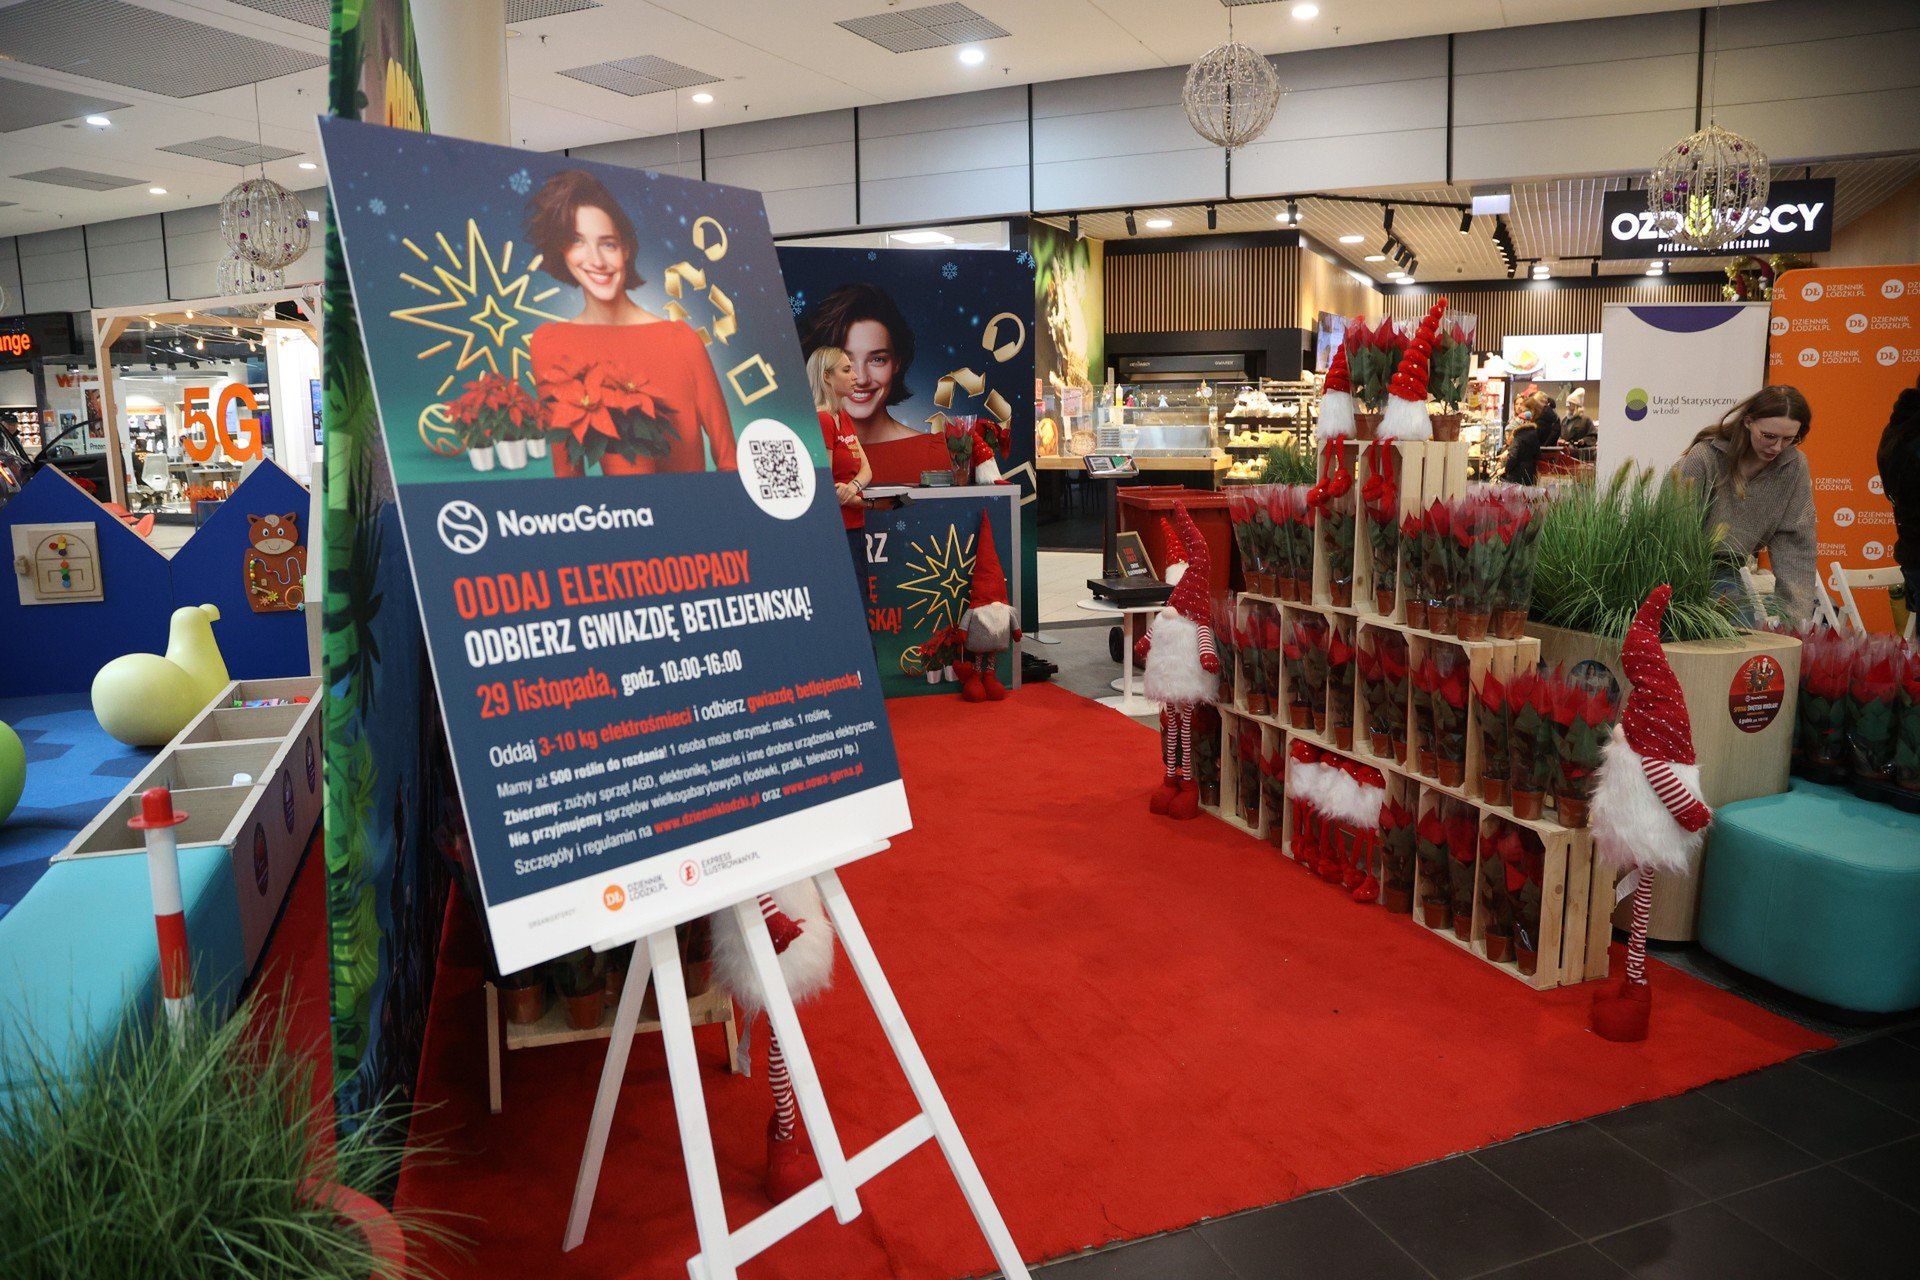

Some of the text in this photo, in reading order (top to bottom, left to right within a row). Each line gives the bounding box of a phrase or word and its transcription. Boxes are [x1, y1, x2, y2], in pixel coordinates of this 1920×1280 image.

[182, 383, 264, 462] 5G
[1653, 396, 1737, 406] Urząd Statystyczny
[496, 503, 654, 537] NowaGórna
[453, 549, 750, 619] ODDAJ ELEKTROODPADY
[464, 618, 576, 668] ODBIERZ
[578, 604, 681, 650] GWIAZDĘ
[680, 586, 813, 635] BETLEJEMSKĄ!
[476, 649, 742, 719] 29 listopada, godz. 10:00-16:00
[489, 670, 863, 768] Oddaj 3-10 kg elektrośmieci i odbierz gwiazdę betlejemską!
[496, 708, 833, 799] Mamy aż 500 roślin do rozdania! 1 osoba może otrzymać maks. 1 roślinę.
[503, 802, 563, 826] Zbieramy:
[564, 792, 597, 810] zużyty
[599, 782, 631, 802] sprzęt
[659, 765, 710, 785] elektronikę,
[711, 754, 741, 772] baterie
[746, 748, 765, 763] inne
[765, 742, 794, 758] drobne
[795, 731, 835, 750] urządzenia
[835, 720, 877, 738] elektryczne.
[508, 833, 530, 848] Nie
[531, 812, 603, 844] przyjmujemy
[604, 800, 650, 823] sprzętów
[651, 772, 742, 809] wielkogabarytowych
[781, 757, 805, 775] pralki,
[806, 747, 843, 766] telewizory
[514, 846, 574, 876] Szczegóły
[576, 843, 582, 857] i
[583, 829, 637, 855] regulamin
[639, 826, 653, 840] na
[653, 792, 760, 834] www.dzienniklodzki.pl
[762, 787, 781, 802] oraz
[628, 874, 661, 893] DZIENNIK
[701, 851, 732, 868] EXPRESS
